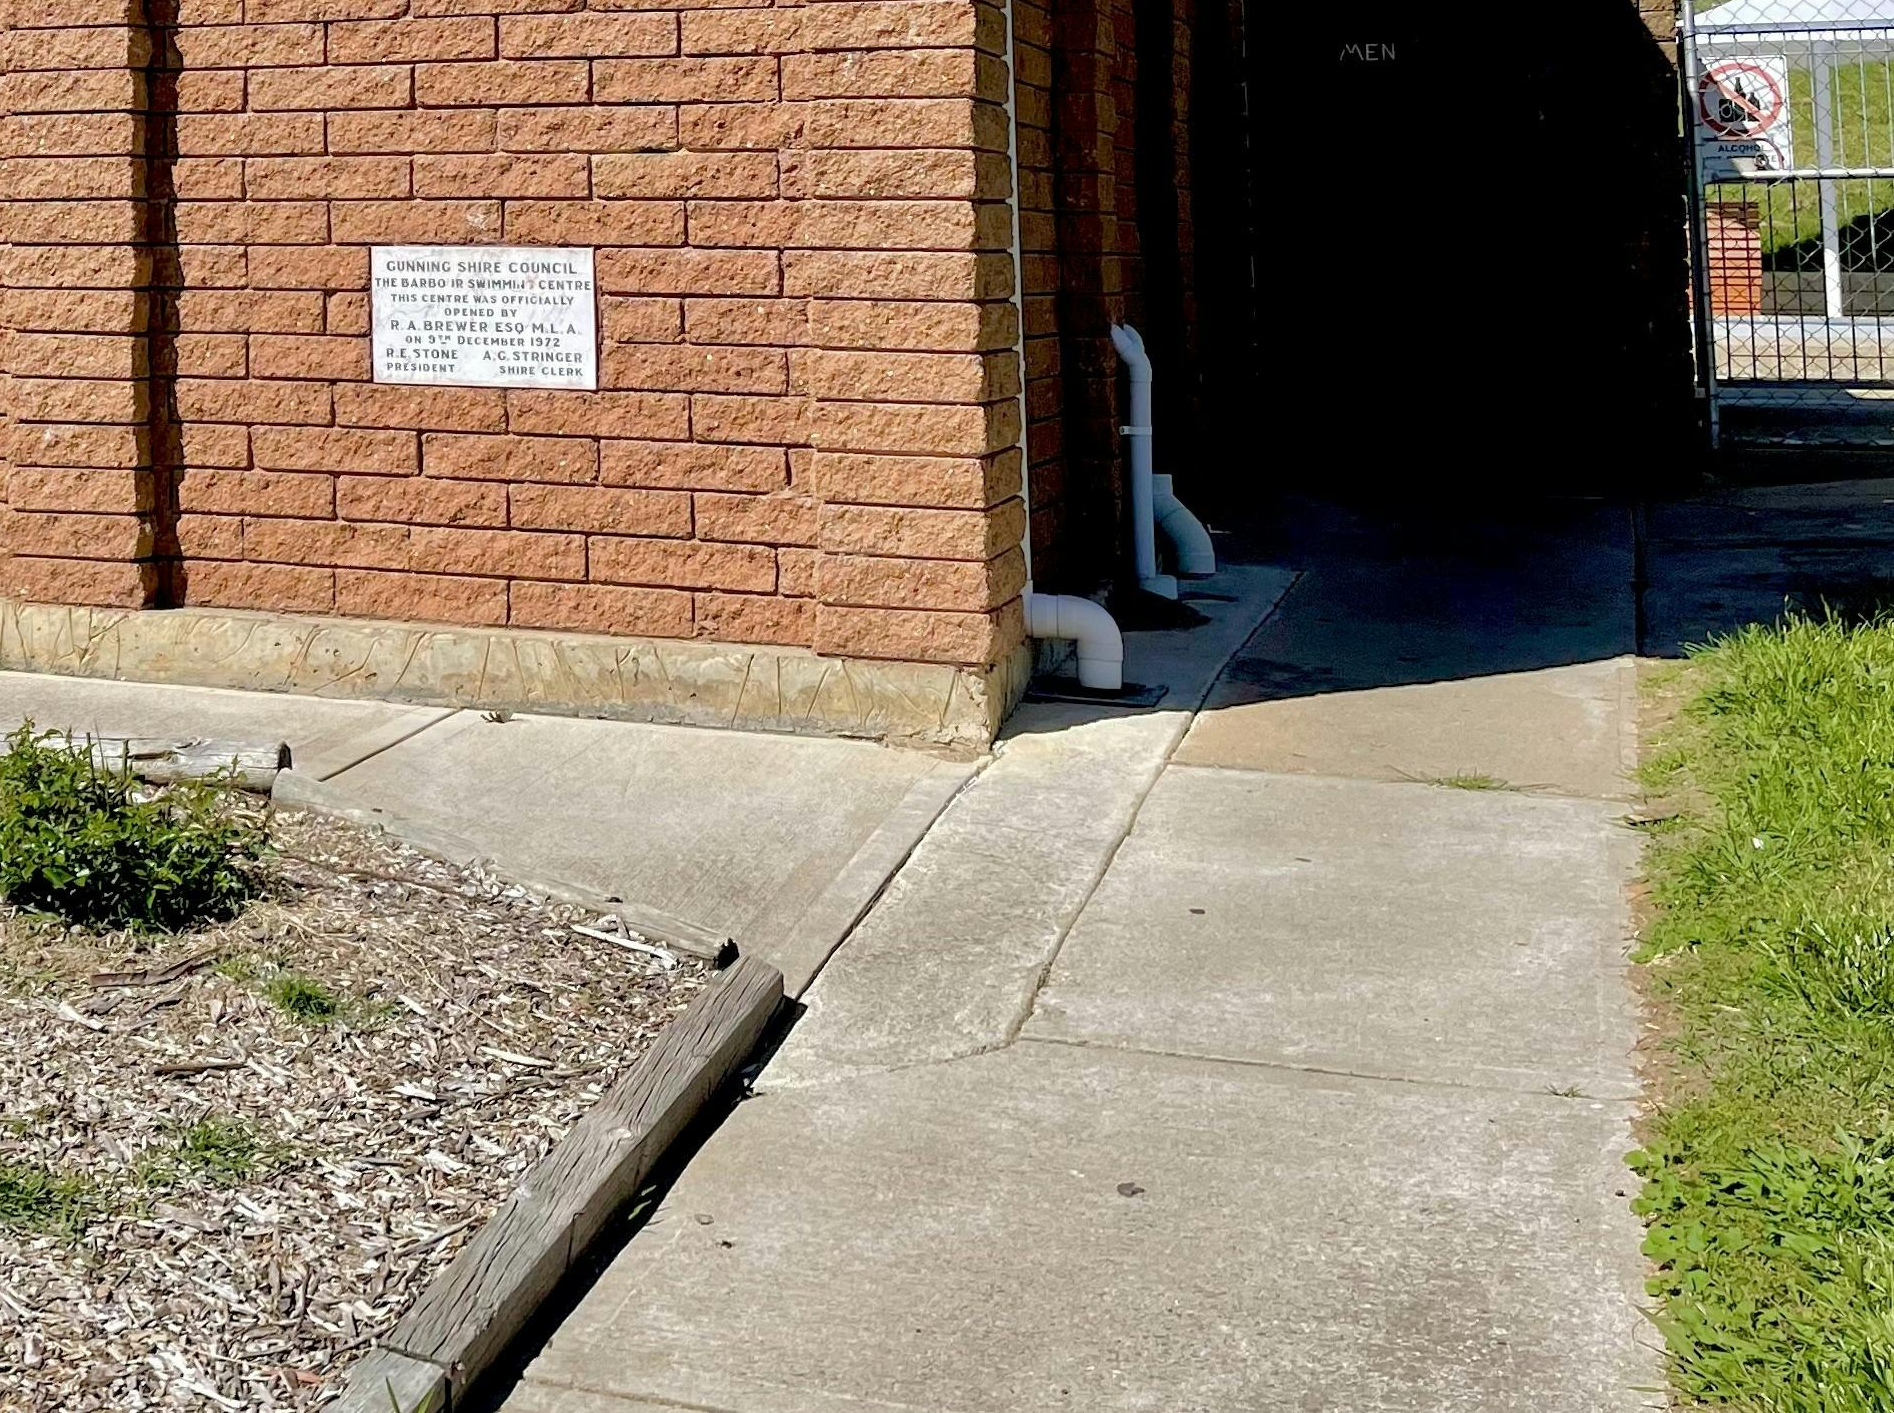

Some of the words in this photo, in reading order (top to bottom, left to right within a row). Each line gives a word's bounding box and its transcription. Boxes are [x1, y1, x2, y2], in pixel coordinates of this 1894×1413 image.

[1339, 43, 1395, 61] MEN
[386, 260, 451, 272] GUNNING
[457, 261, 501, 273] SHIRE
[508, 262, 577, 274] COUNCIL
[375, 277, 398, 288] THE
[467, 279, 535, 290] SWIMMIN
[538, 280, 592, 291] CENTRE
[391, 293, 418, 303] THIS
[421, 294, 469, 304] CENTRE
[473, 295, 497, 304] WAS
[501, 295, 574, 305] OFFICIALLY
[444, 307, 494, 317] OPENED
[501, 308, 517, 318] BY
[405, 335, 422, 344] ON
[530, 337, 561, 347] 1972
[386, 362, 455, 372] PRESIDENT
[499, 365, 535, 375] SHIRE
[541, 367, 583, 376] CLERK
